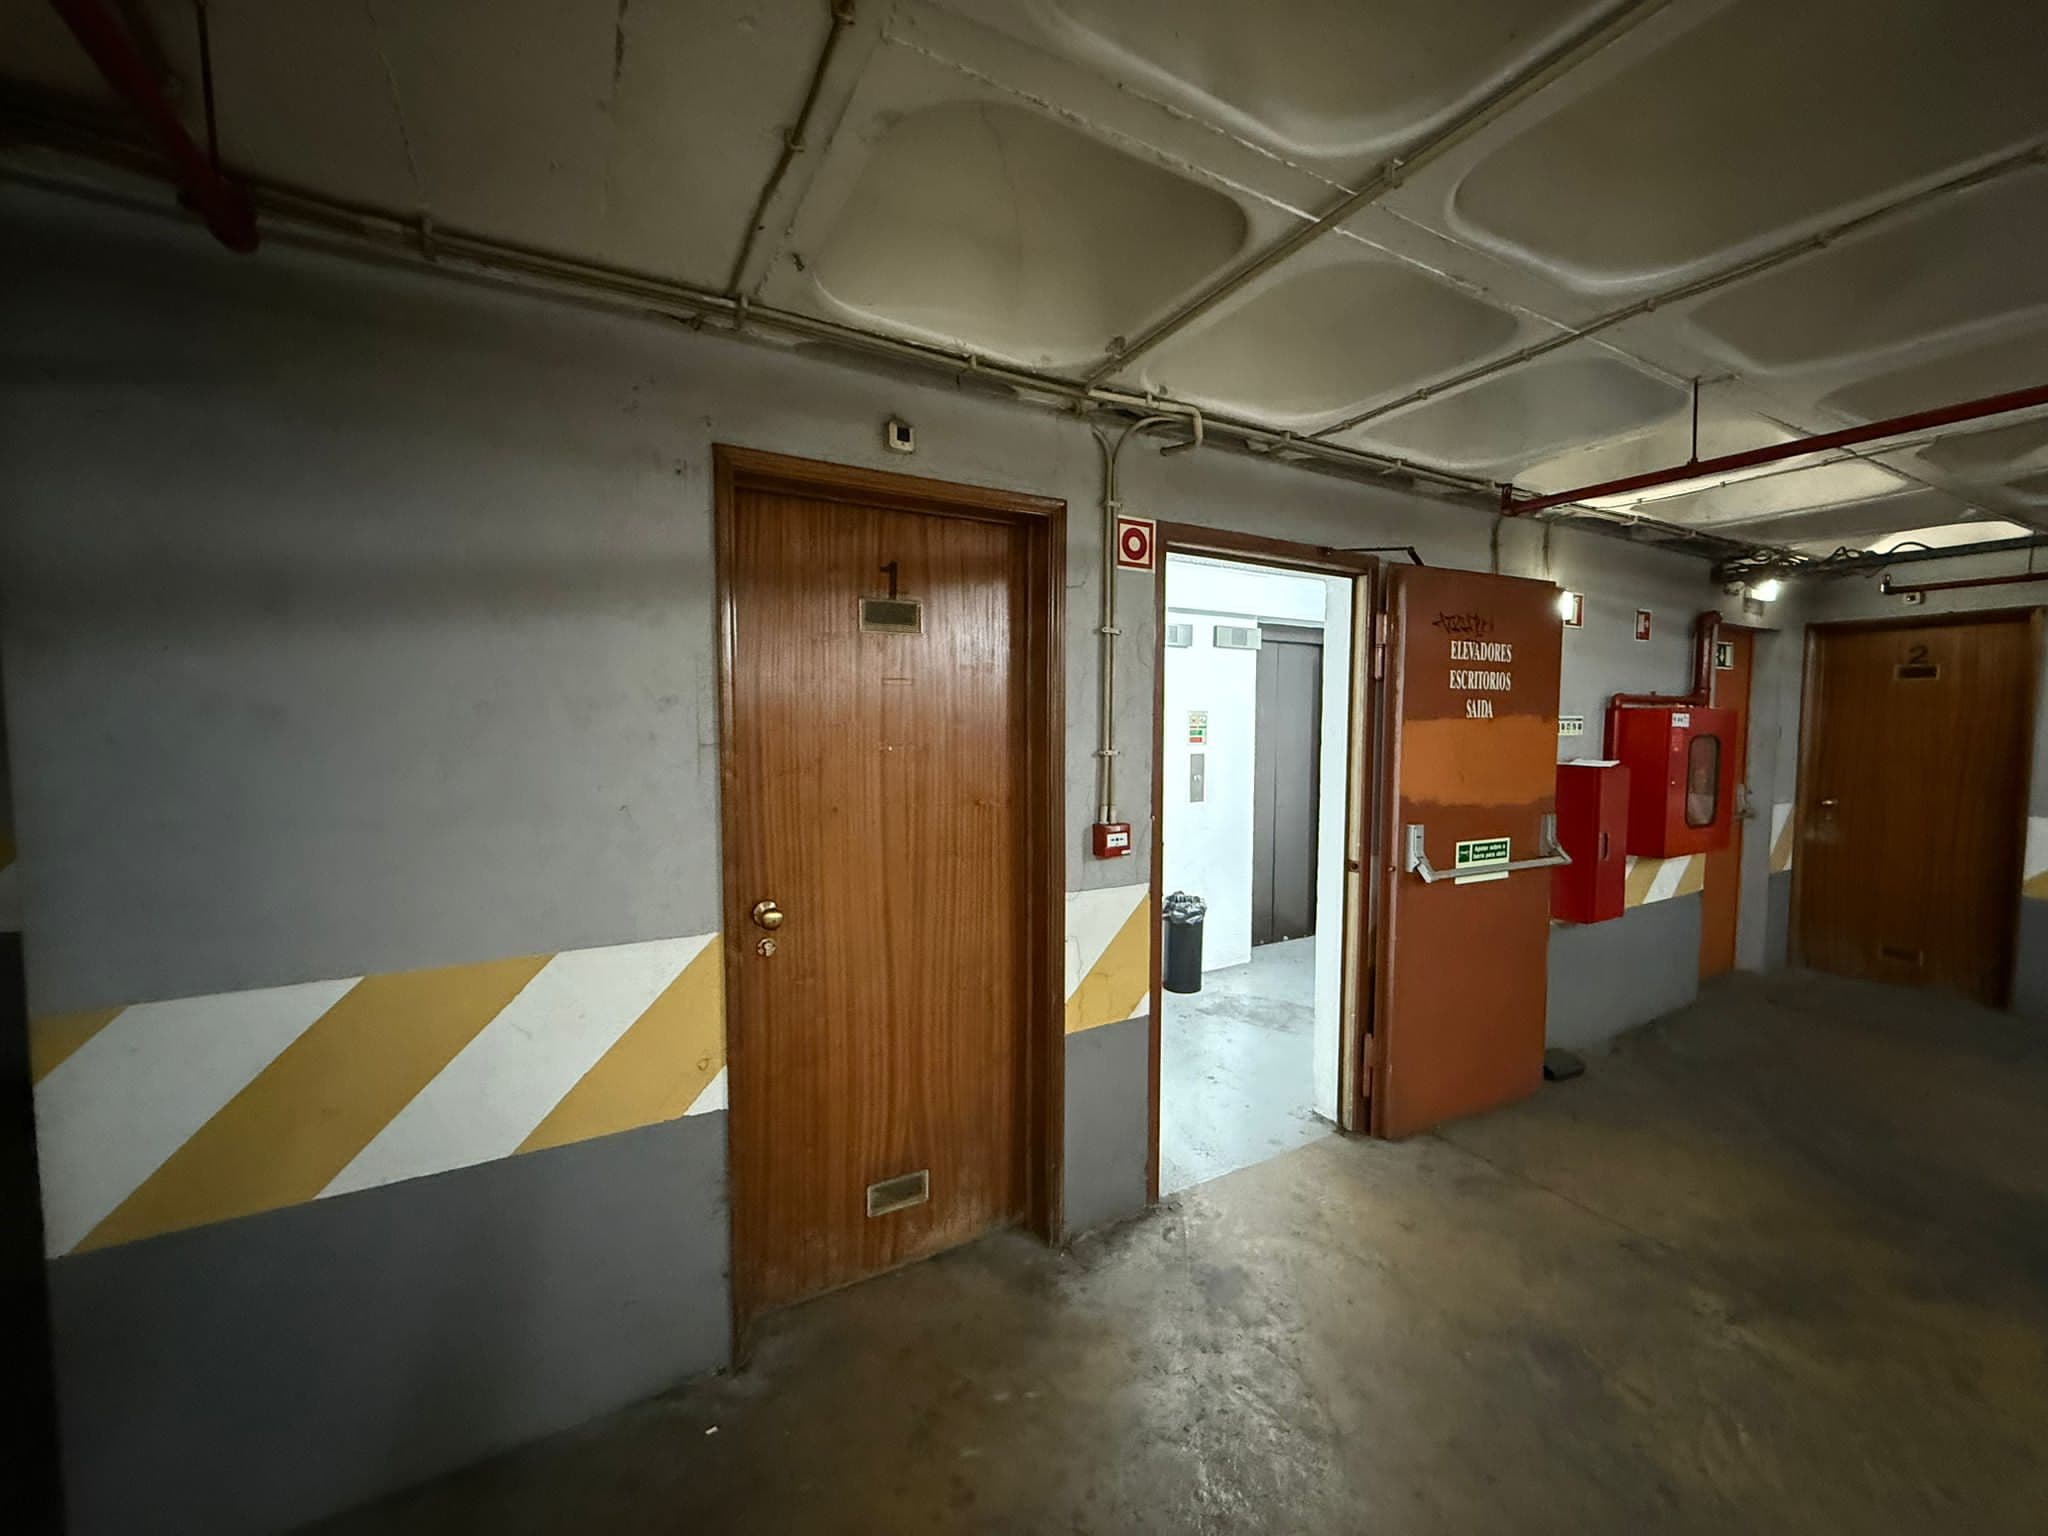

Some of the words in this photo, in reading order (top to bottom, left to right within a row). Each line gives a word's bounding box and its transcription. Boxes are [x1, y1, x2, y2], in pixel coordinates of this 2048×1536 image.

[879, 560, 898, 599] 1
[1451, 640, 1512, 662] ELEVADORES
[1908, 644, 1929, 664] 2
[1449, 670, 1511, 691] ESCRITORIOS
[1466, 698, 1493, 719] SAIDA
